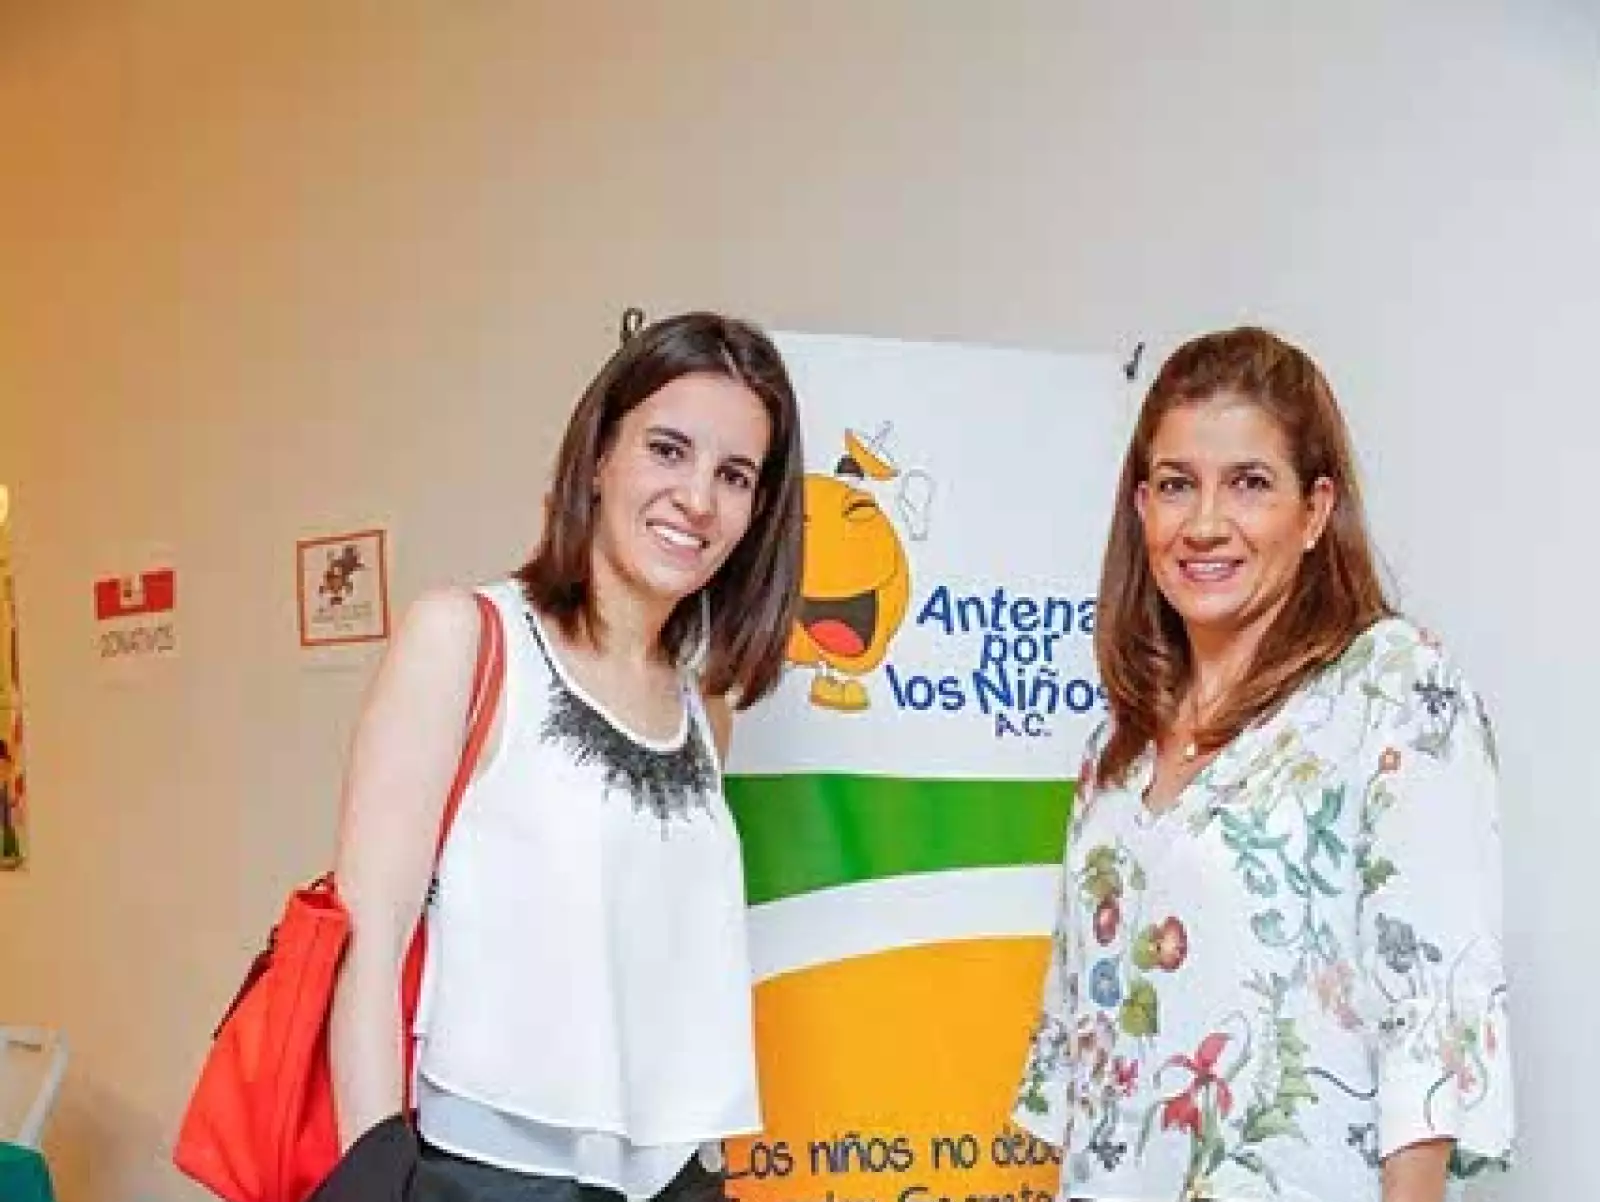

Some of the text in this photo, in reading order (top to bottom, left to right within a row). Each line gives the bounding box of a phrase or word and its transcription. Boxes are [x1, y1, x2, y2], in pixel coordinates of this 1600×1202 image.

[980, 631, 1063, 669] por
[886, 665, 966, 712] los
[995, 713, 1053, 737] A.C.
[722, 1140, 794, 1179] Los
[808, 1131, 914, 1176] niños
[931, 1133, 978, 1169] no
